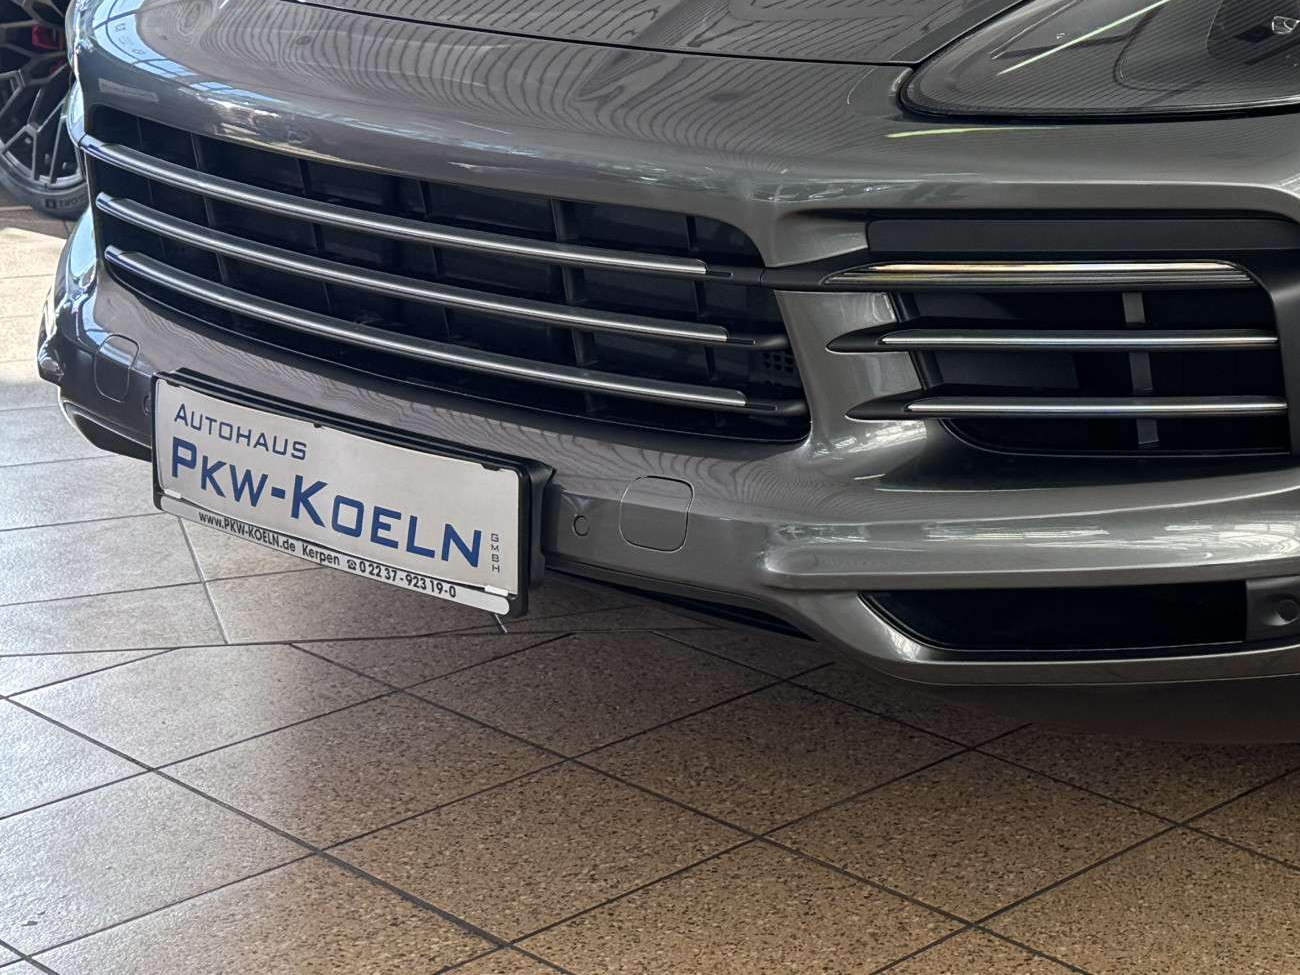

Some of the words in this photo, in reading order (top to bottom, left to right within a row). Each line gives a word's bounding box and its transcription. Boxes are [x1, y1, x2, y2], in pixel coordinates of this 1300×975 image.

[174, 403, 307, 461] AUTOHAUS
[198, 511, 296, 552] www.PKW-KOELN.de
[302, 543, 340, 565] Kerpen
